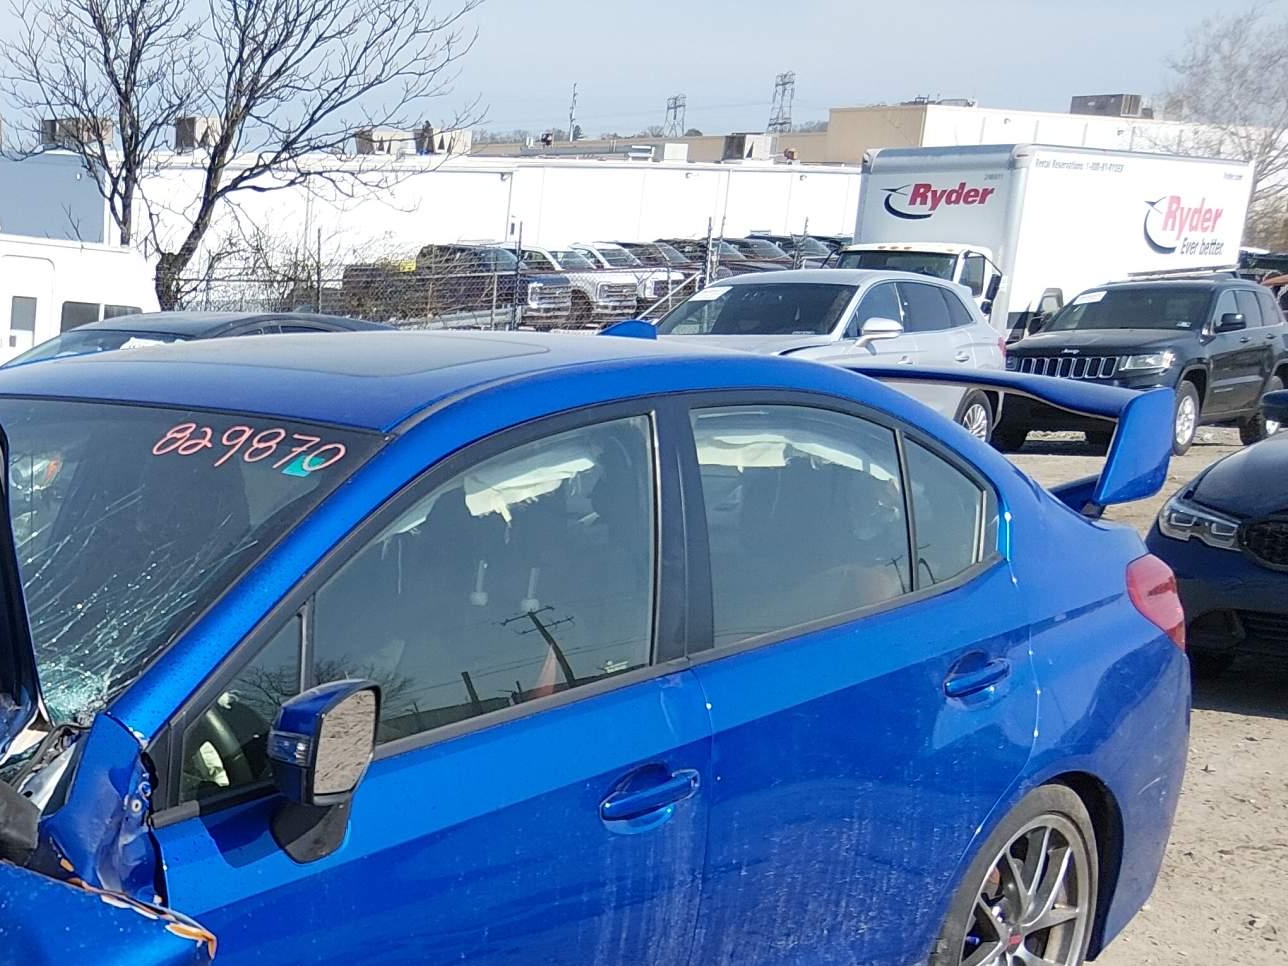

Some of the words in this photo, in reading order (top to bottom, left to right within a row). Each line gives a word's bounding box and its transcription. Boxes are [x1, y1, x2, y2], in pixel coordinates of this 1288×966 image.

[908, 182, 995, 211] Ryder
[1162, 195, 1224, 241] Ryder
[1180, 237, 1199, 255] Ever
[152, 422, 346, 472] 829870
